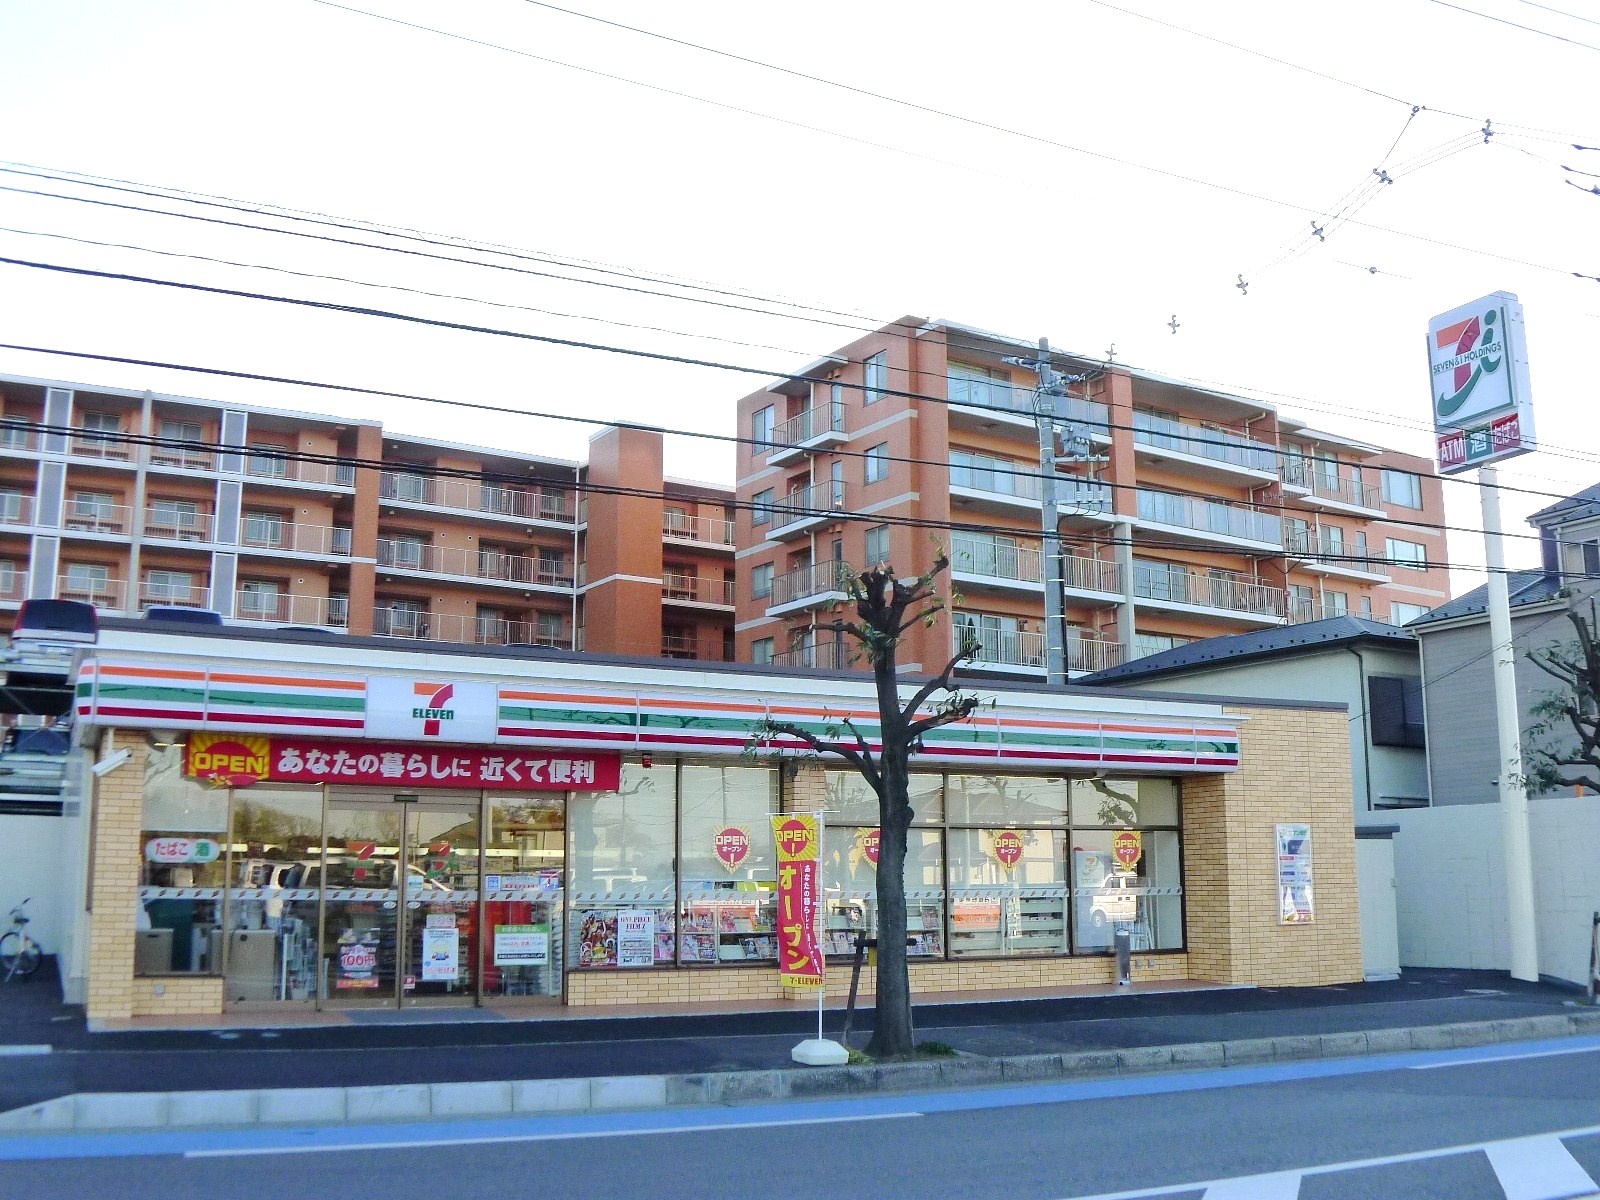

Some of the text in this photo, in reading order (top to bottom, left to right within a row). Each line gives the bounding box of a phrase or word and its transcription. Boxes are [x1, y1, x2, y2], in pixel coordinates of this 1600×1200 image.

[1464, 341, 1502, 363] HOLDINGS
[1469, 430, 1487, 454] 酒
[1494, 421, 1519, 446] たばこ
[1441, 438, 1464, 462] ATM
[194, 752, 264, 774] OPEN
[277, 747, 596, 784] あなたの暮らしに 近くて便利
[715, 835, 749, 846] OPEN
[776, 829, 816, 843] OPEN
[863, 836, 880, 847] OP
[994, 838, 1022, 848] OPEN
[1114, 839, 1140, 848] OPEN
[155, 842, 188, 856] たばこ
[779, 865, 809, 971] オープン
